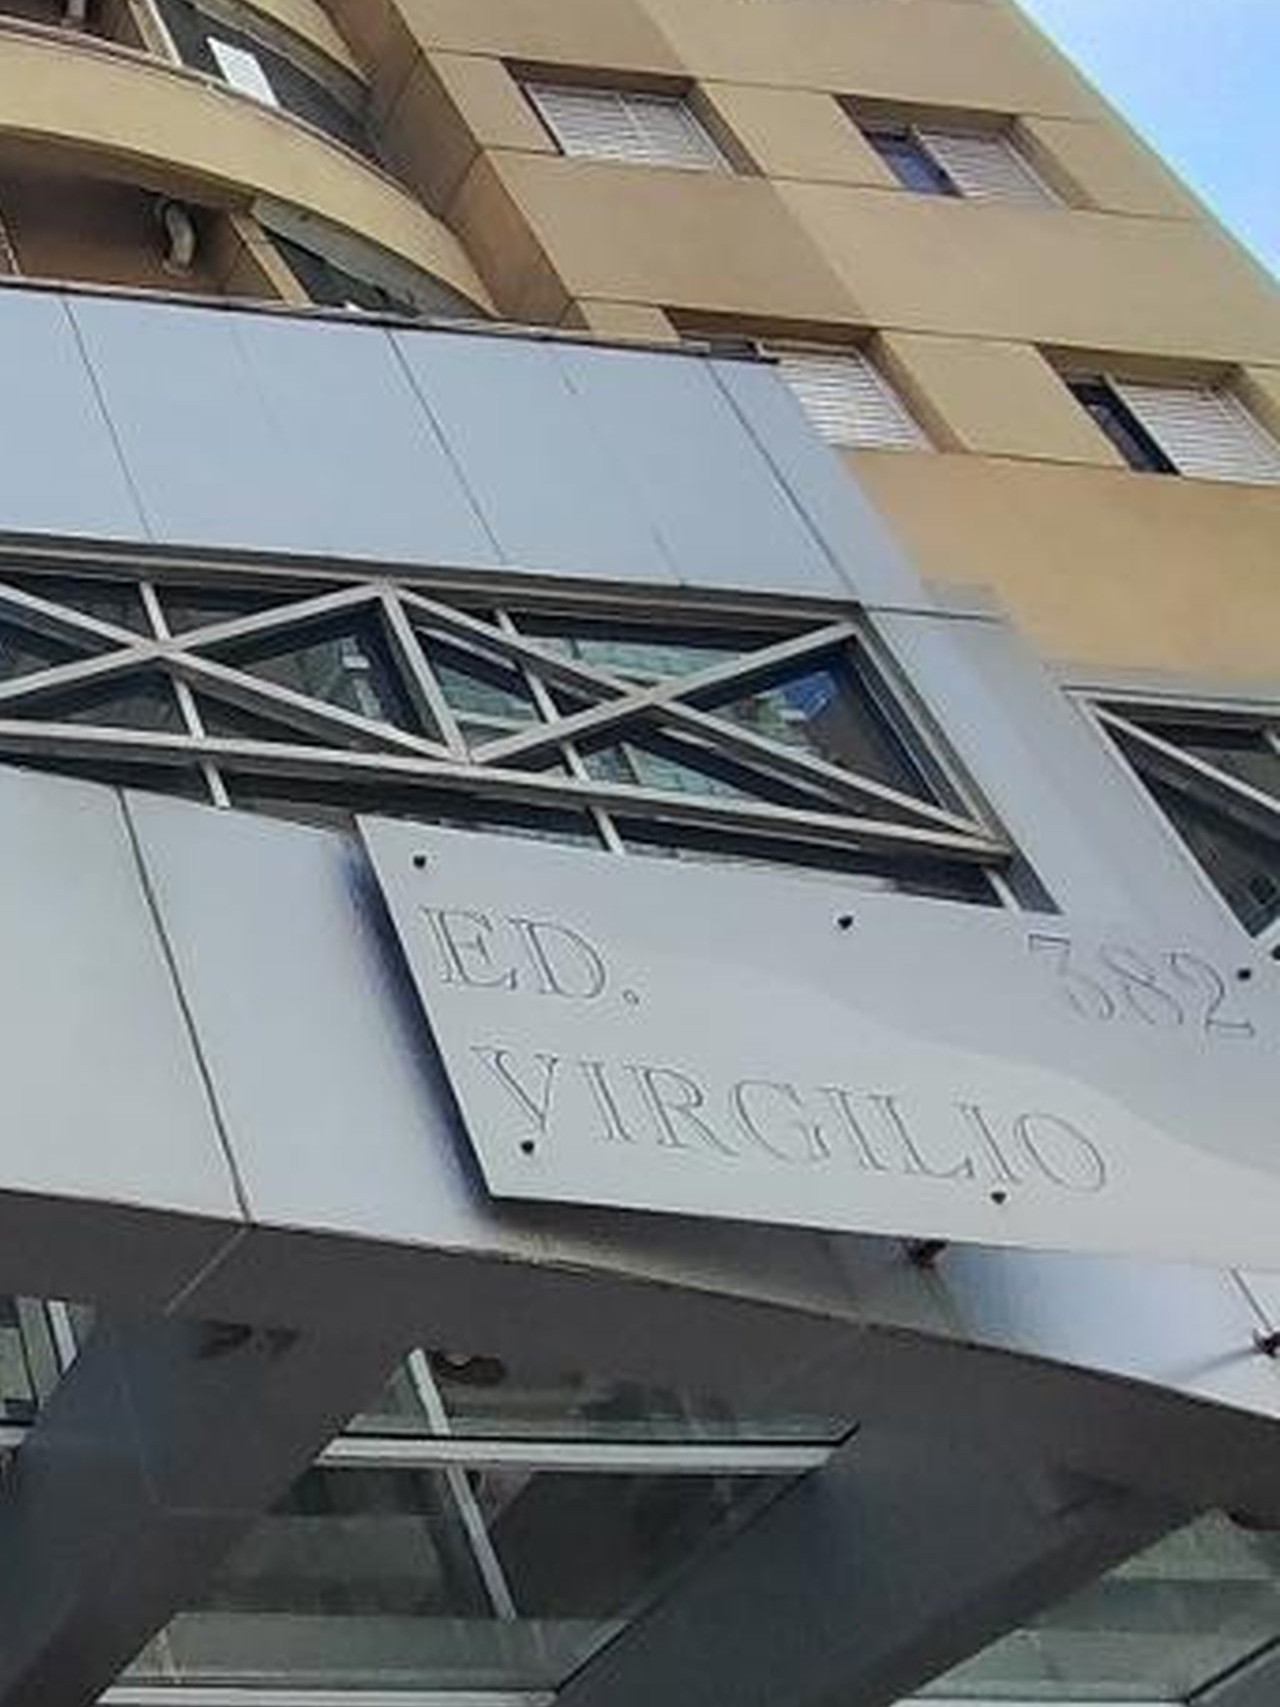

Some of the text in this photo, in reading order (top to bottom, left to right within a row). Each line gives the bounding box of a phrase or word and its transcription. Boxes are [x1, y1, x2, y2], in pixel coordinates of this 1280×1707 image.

[419, 905, 639, 1006] ED.
[1028, 933, 1255, 1042] 382
[470, 1044, 1106, 1195] VIRGILIO
